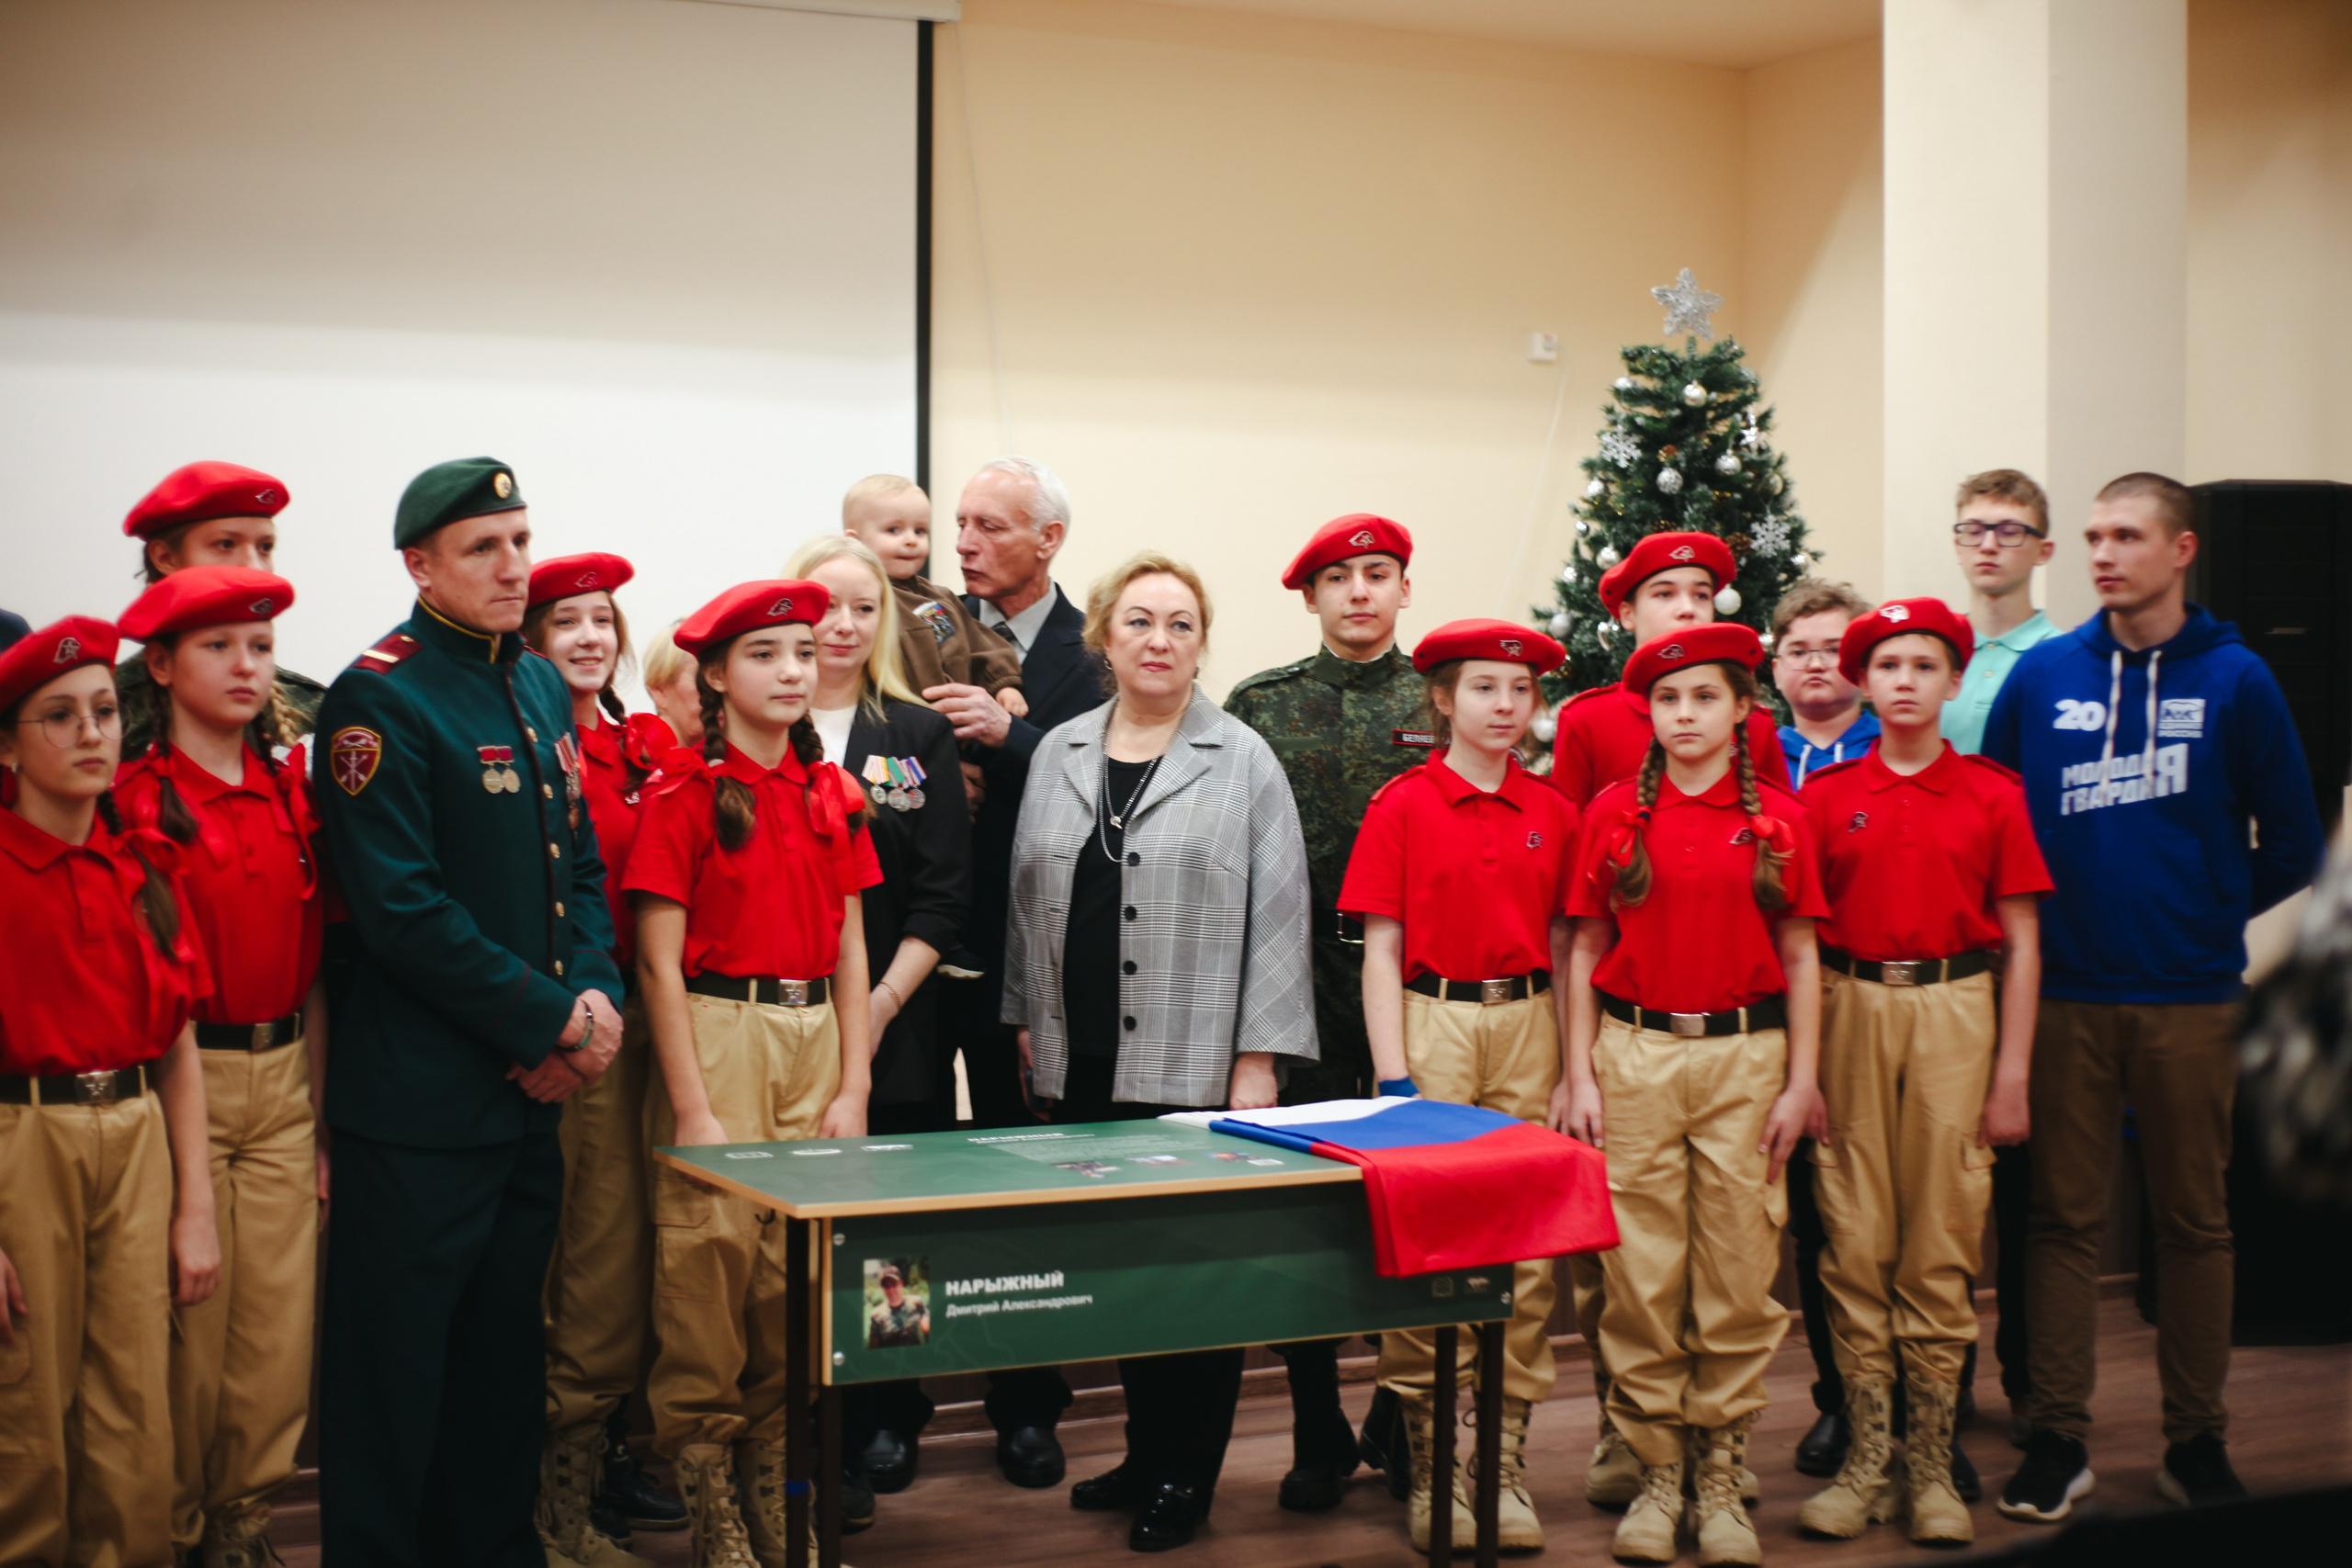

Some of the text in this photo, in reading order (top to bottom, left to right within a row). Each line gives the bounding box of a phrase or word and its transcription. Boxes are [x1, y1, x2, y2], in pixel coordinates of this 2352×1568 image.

[2052, 698, 2107, 732] 20
[2062, 742, 2188, 792] МОЛОДЯ
[945, 1269, 1065, 1296] НАРЫЖНЫЙ
[945, 1294, 1093, 1318] Дмитрий Александрович
